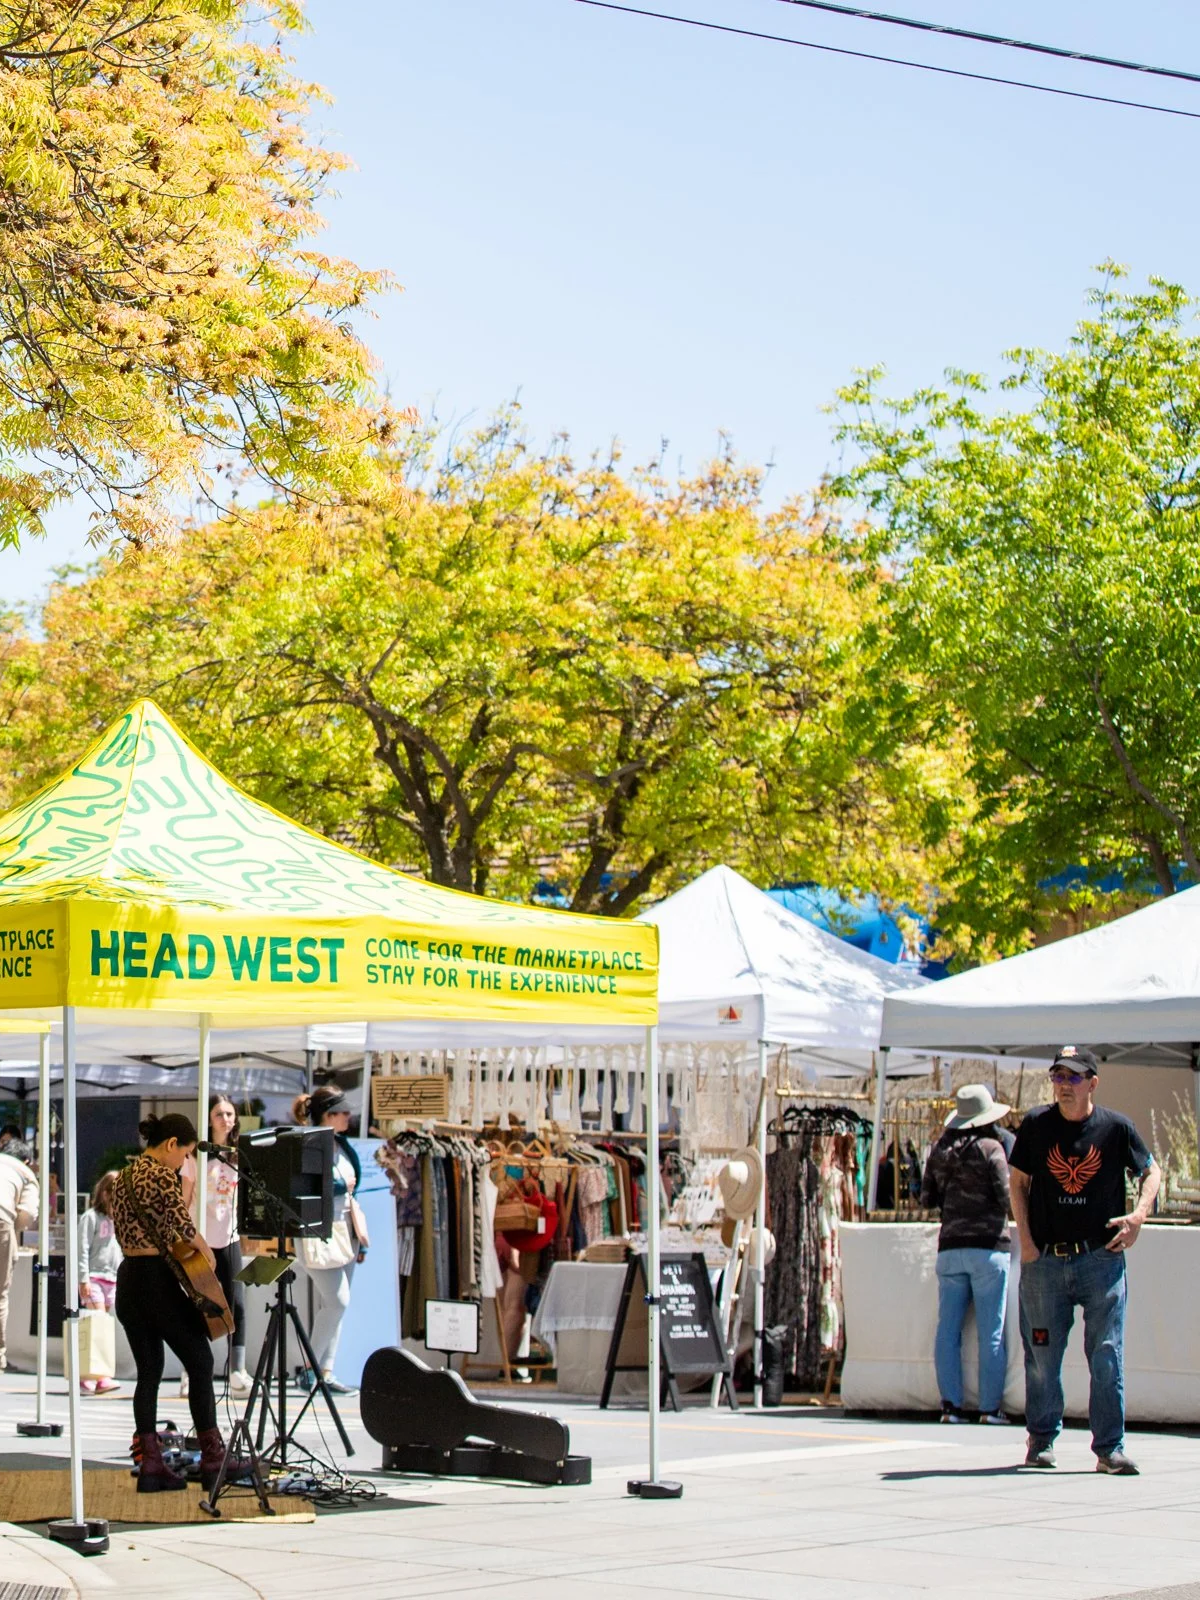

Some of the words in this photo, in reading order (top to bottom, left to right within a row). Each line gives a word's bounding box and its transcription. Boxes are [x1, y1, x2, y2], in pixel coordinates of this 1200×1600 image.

[90, 929, 216, 980] HEAD
[223, 935, 345, 984] WEST
[365, 937, 421, 960] COME
[427, 941, 463, 963] FOR
[471, 944, 507, 965] THE
[514, 947, 645, 971] MARKETPLACE
[366, 963, 416, 985] STAY
[423, 967, 459, 988] FOR
[467, 969, 502, 991] THE
[510, 971, 618, 995] EXPERIENCE
